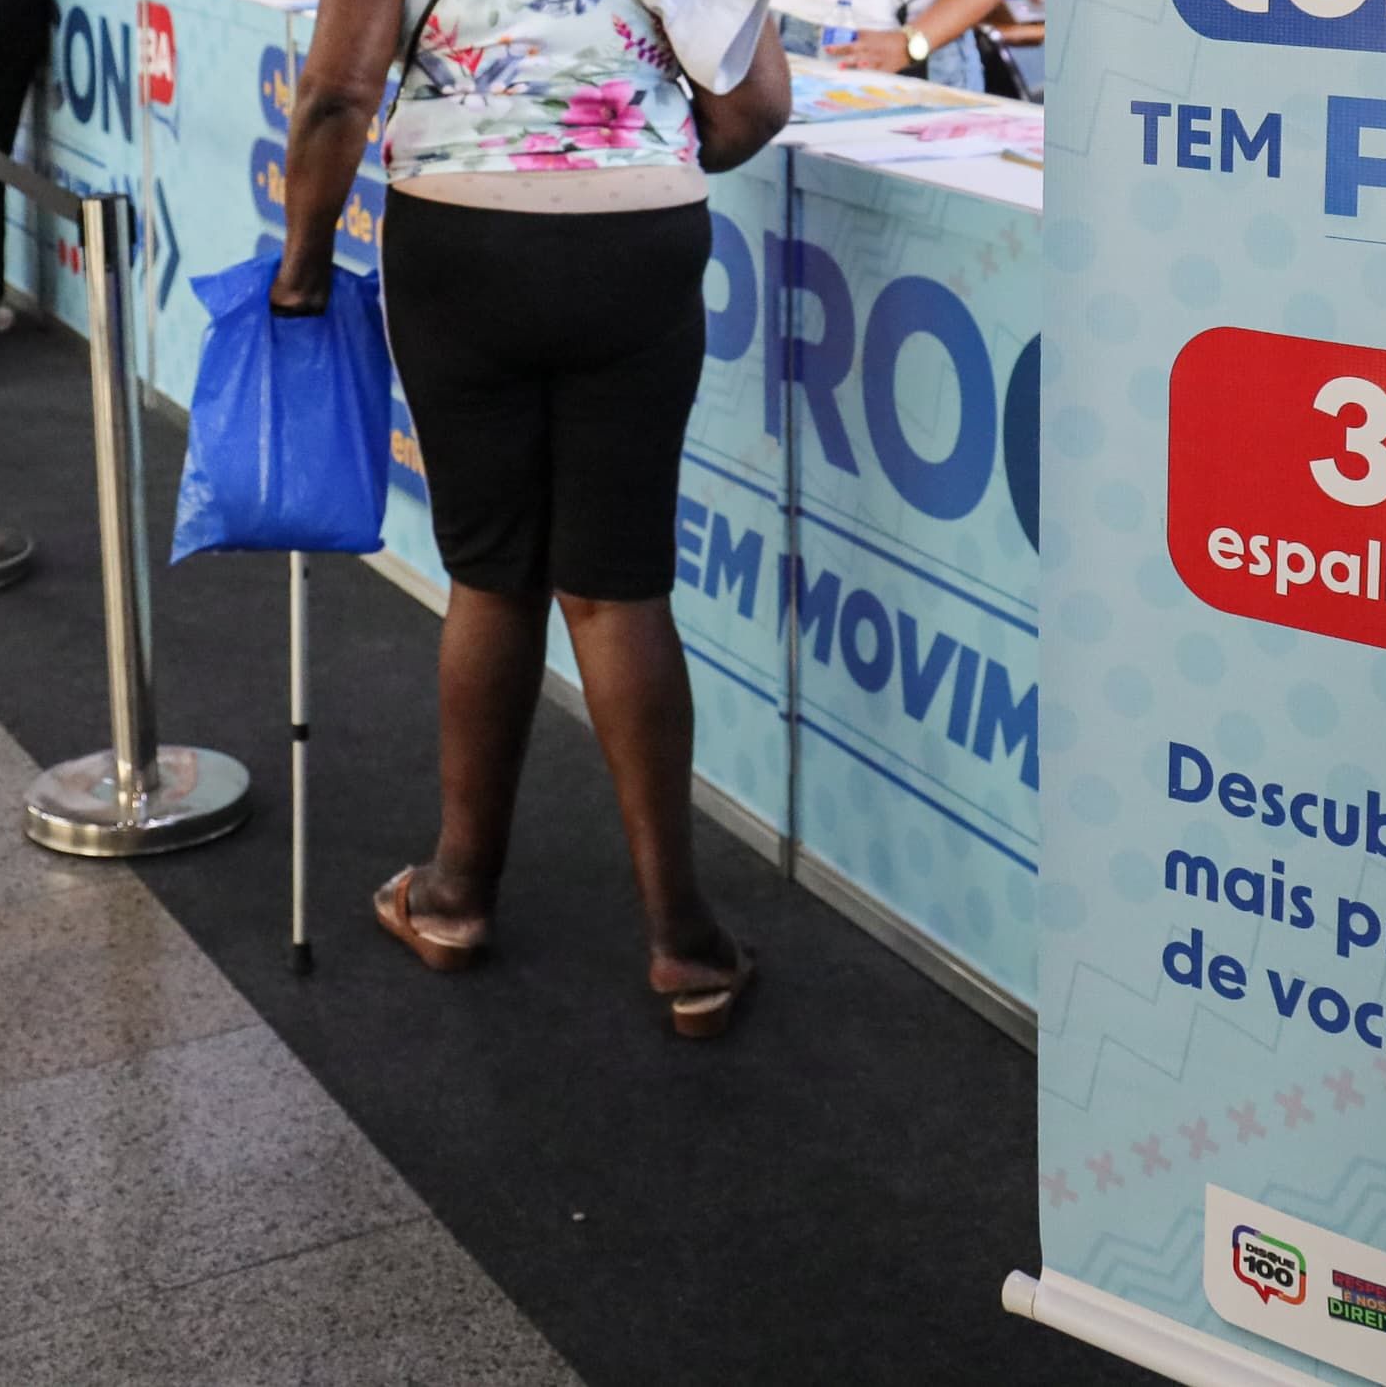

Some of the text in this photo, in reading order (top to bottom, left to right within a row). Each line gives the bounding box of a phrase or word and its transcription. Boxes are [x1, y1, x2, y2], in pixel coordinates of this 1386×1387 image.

[1130, 101, 1282, 178] TEM
[675, 494, 1040, 792] EM MOVIM
[1165, 848, 1315, 930] mais
[1162, 929, 1248, 1002] de
[1243, 1255, 1294, 1289] 100
[1245, 1243, 1295, 1270] DISQUE
